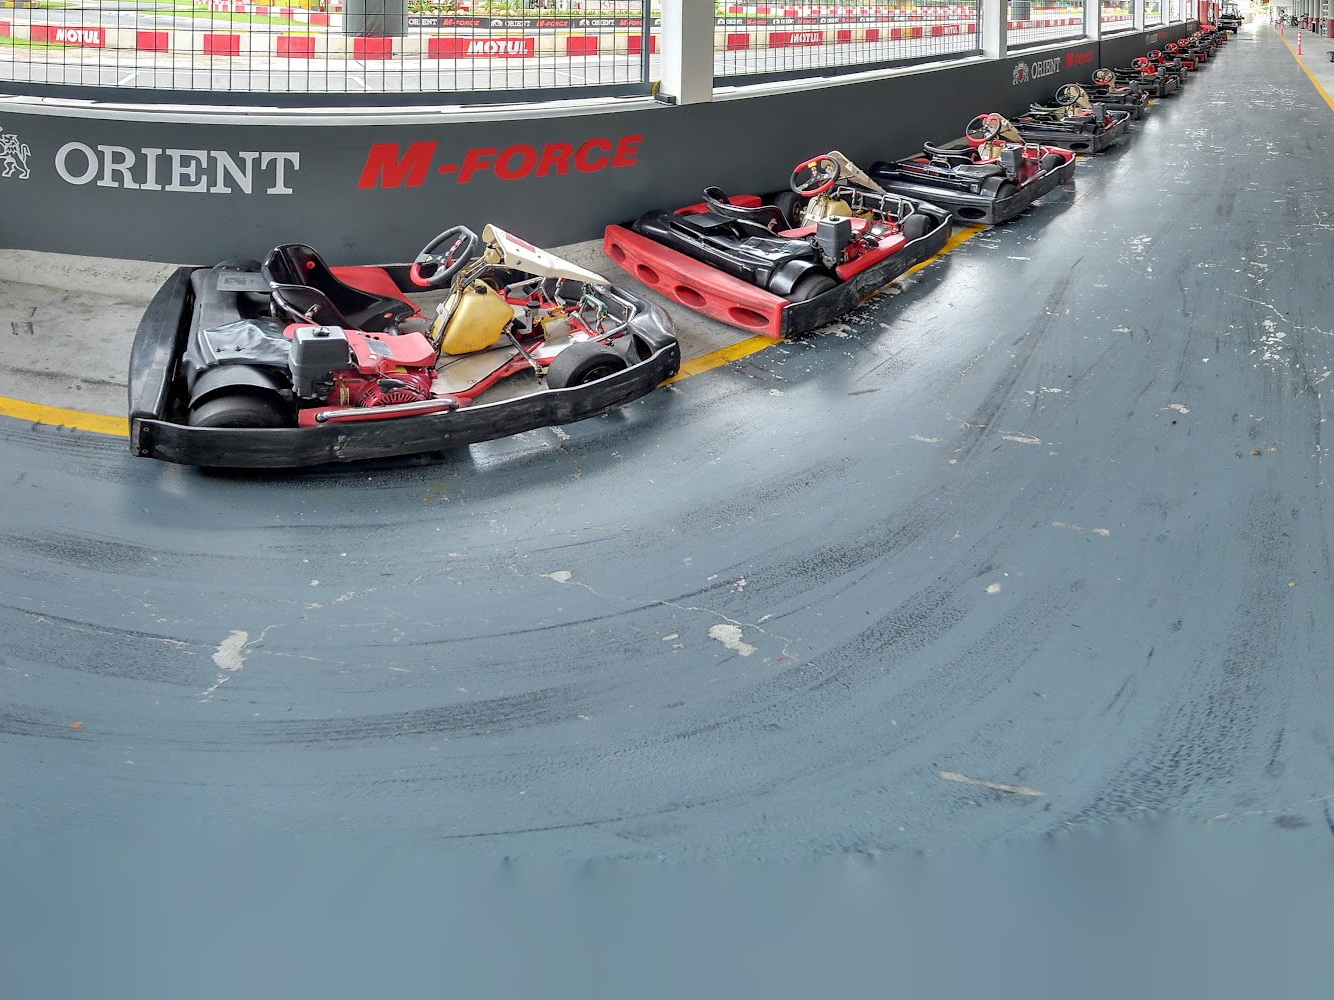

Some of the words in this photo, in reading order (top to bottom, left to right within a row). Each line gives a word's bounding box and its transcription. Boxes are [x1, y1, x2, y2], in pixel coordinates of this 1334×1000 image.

[55, 28, 100, 44] MOTUL
[467, 40, 528, 55] MOTUL
[1030, 57, 1061, 77] ORIENT
[55, 141, 300, 195] ORIENT
[357, 134, 644, 190] M-FORCE
